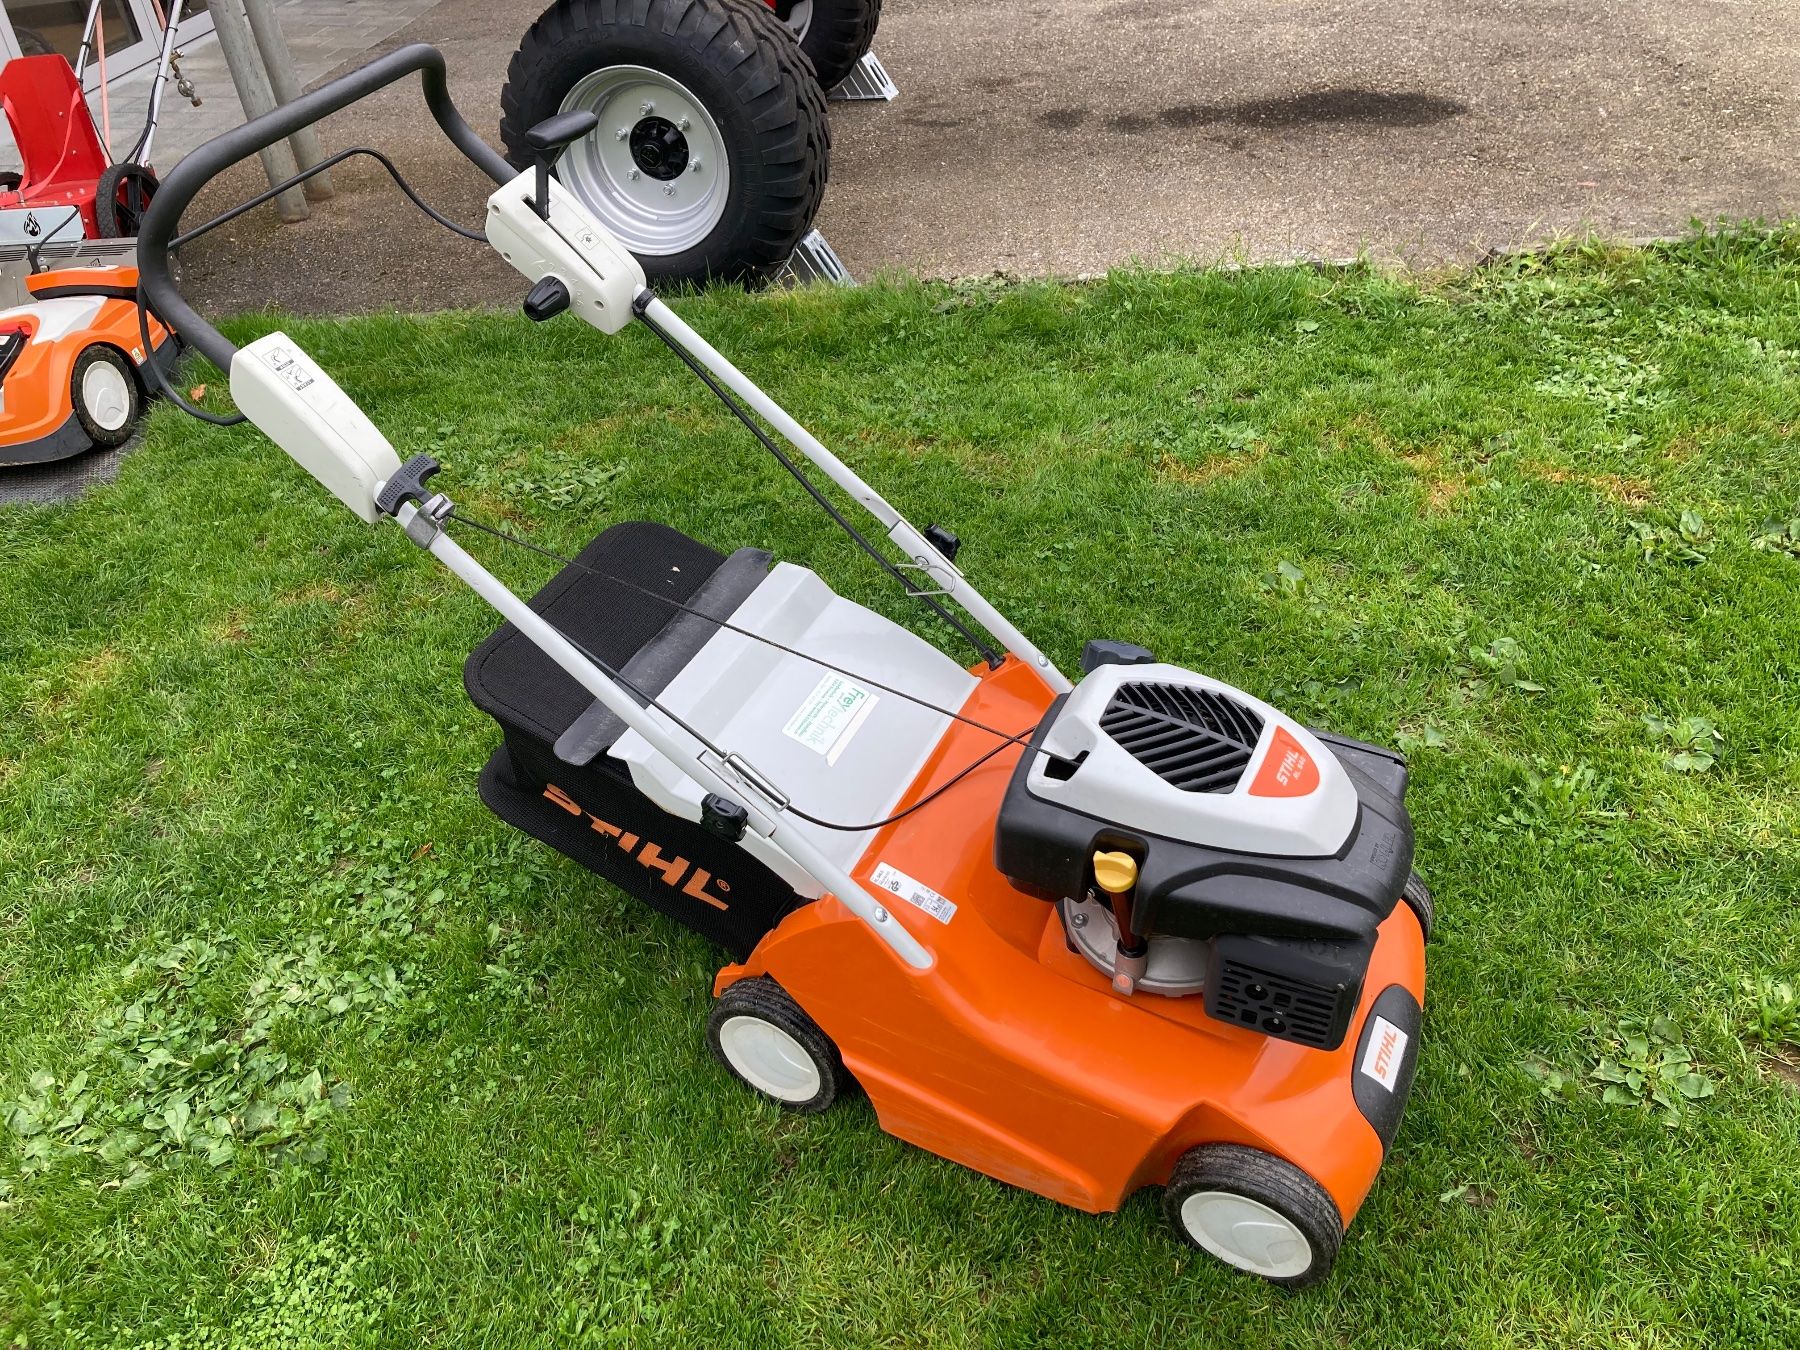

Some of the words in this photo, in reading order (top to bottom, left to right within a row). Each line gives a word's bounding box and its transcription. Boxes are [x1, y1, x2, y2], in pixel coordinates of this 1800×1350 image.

[1276, 750, 1299, 786] STIHL
[543, 782, 730, 911] STIHL
[1374, 1030, 1397, 1080] STIHL
